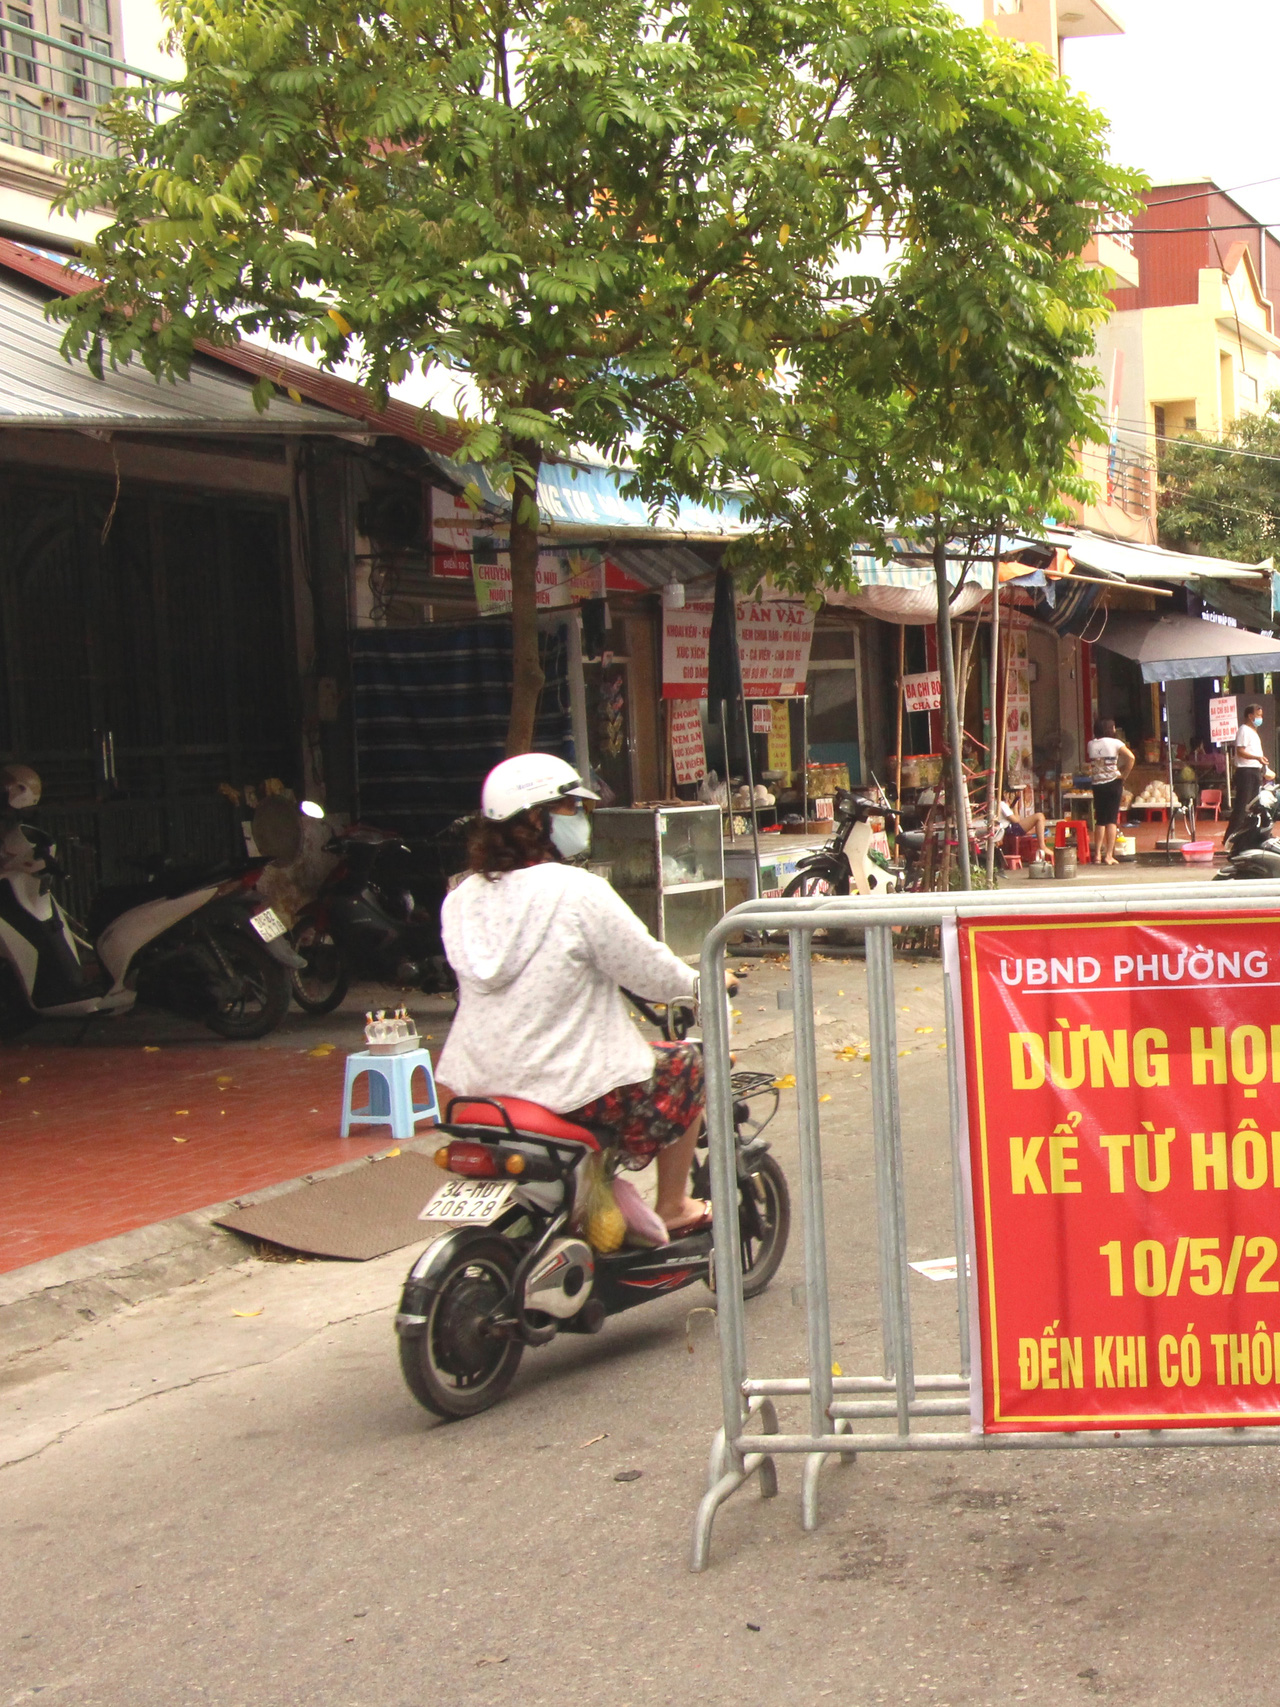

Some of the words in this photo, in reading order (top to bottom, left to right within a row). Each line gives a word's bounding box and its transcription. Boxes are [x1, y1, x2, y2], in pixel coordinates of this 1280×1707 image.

[906, 683, 917, 698] BA
[917, 677, 930, 697] CHỈ
[1001, 956, 1102, 988] UBND
[1114, 941, 1268, 983] PHƯỜNG
[1009, 1018, 1170, 1091] DỪNG
[1010, 1111, 1083, 1195] KỂ
[1099, 1121, 1176, 1194] TỪ
[425, 1200, 497, 1217] 206.28
[1018, 1320, 1084, 1390] ĐẾN
[1094, 1336, 1147, 1389] KHI
[1158, 1323, 1202, 1388] CÓ
